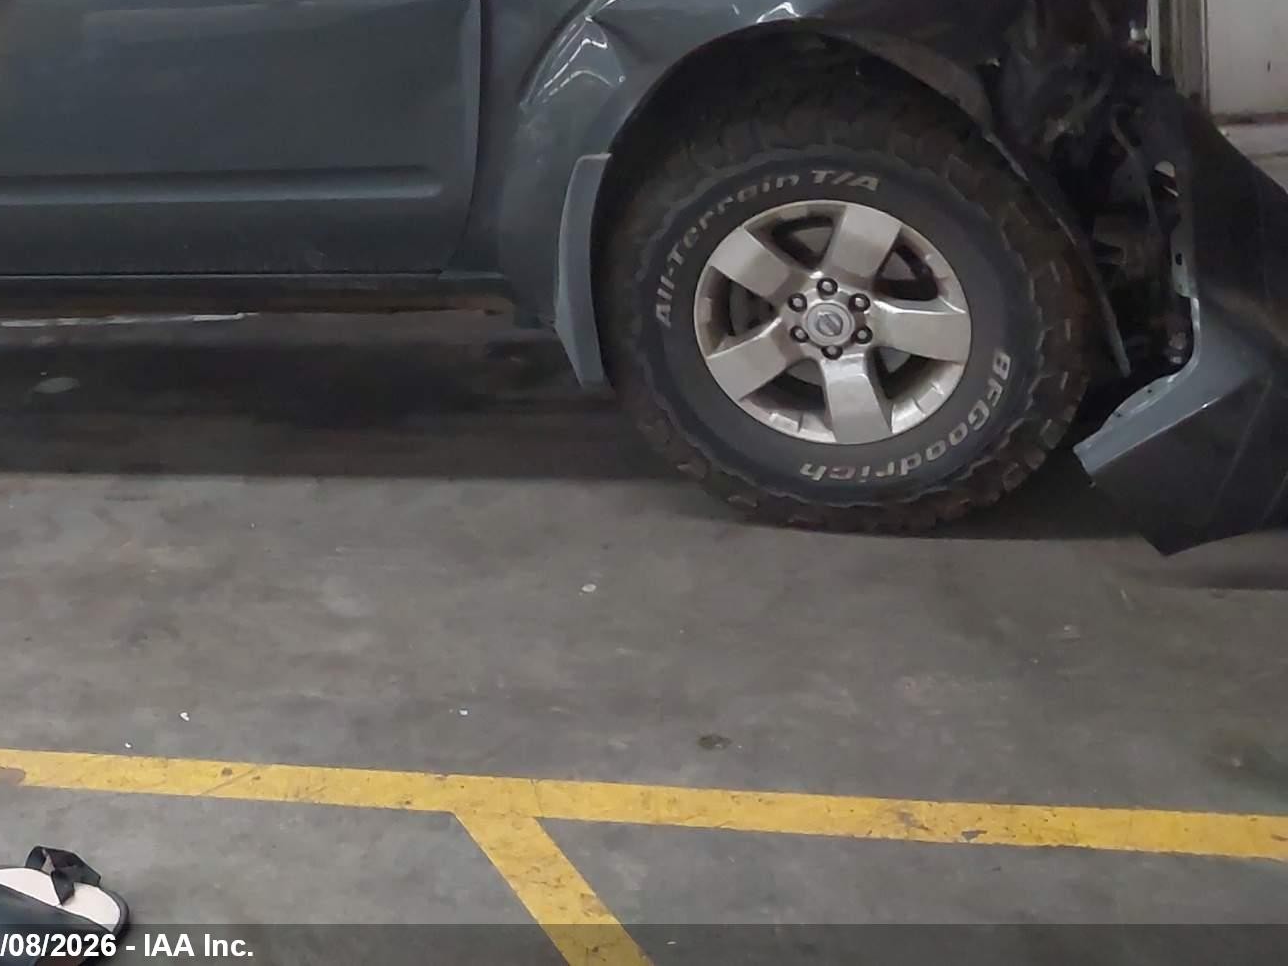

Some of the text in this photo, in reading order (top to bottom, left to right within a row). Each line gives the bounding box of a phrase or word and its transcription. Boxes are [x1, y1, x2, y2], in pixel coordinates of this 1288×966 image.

[655, 169, 882, 328] All-Terrain T/A
[801, 349, 1011, 481] BFGoodrich
